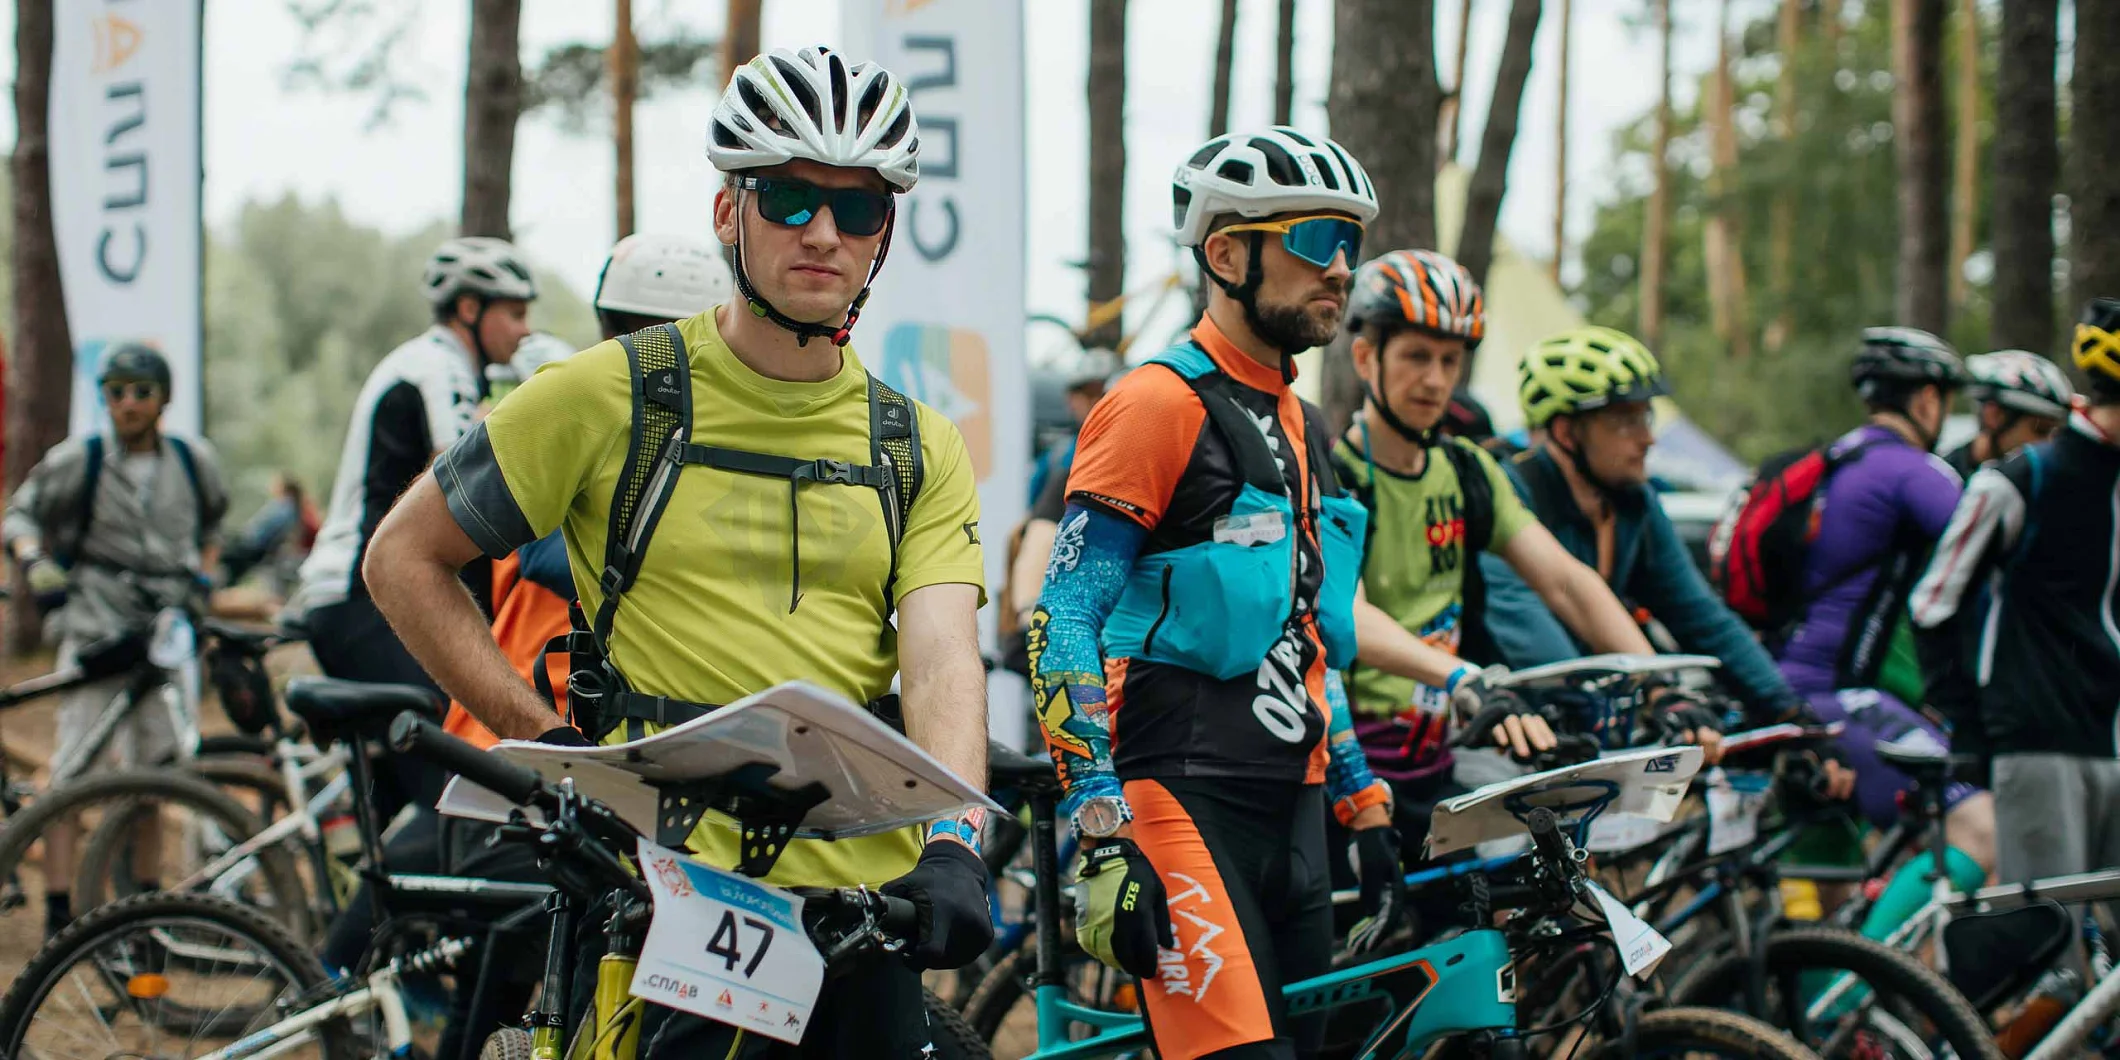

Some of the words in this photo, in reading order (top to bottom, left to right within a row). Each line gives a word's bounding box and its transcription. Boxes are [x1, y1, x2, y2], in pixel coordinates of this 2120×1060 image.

[657, 386, 681, 396] deuter
[882, 419, 905, 429] deuter
[706, 910, 774, 979] 47
